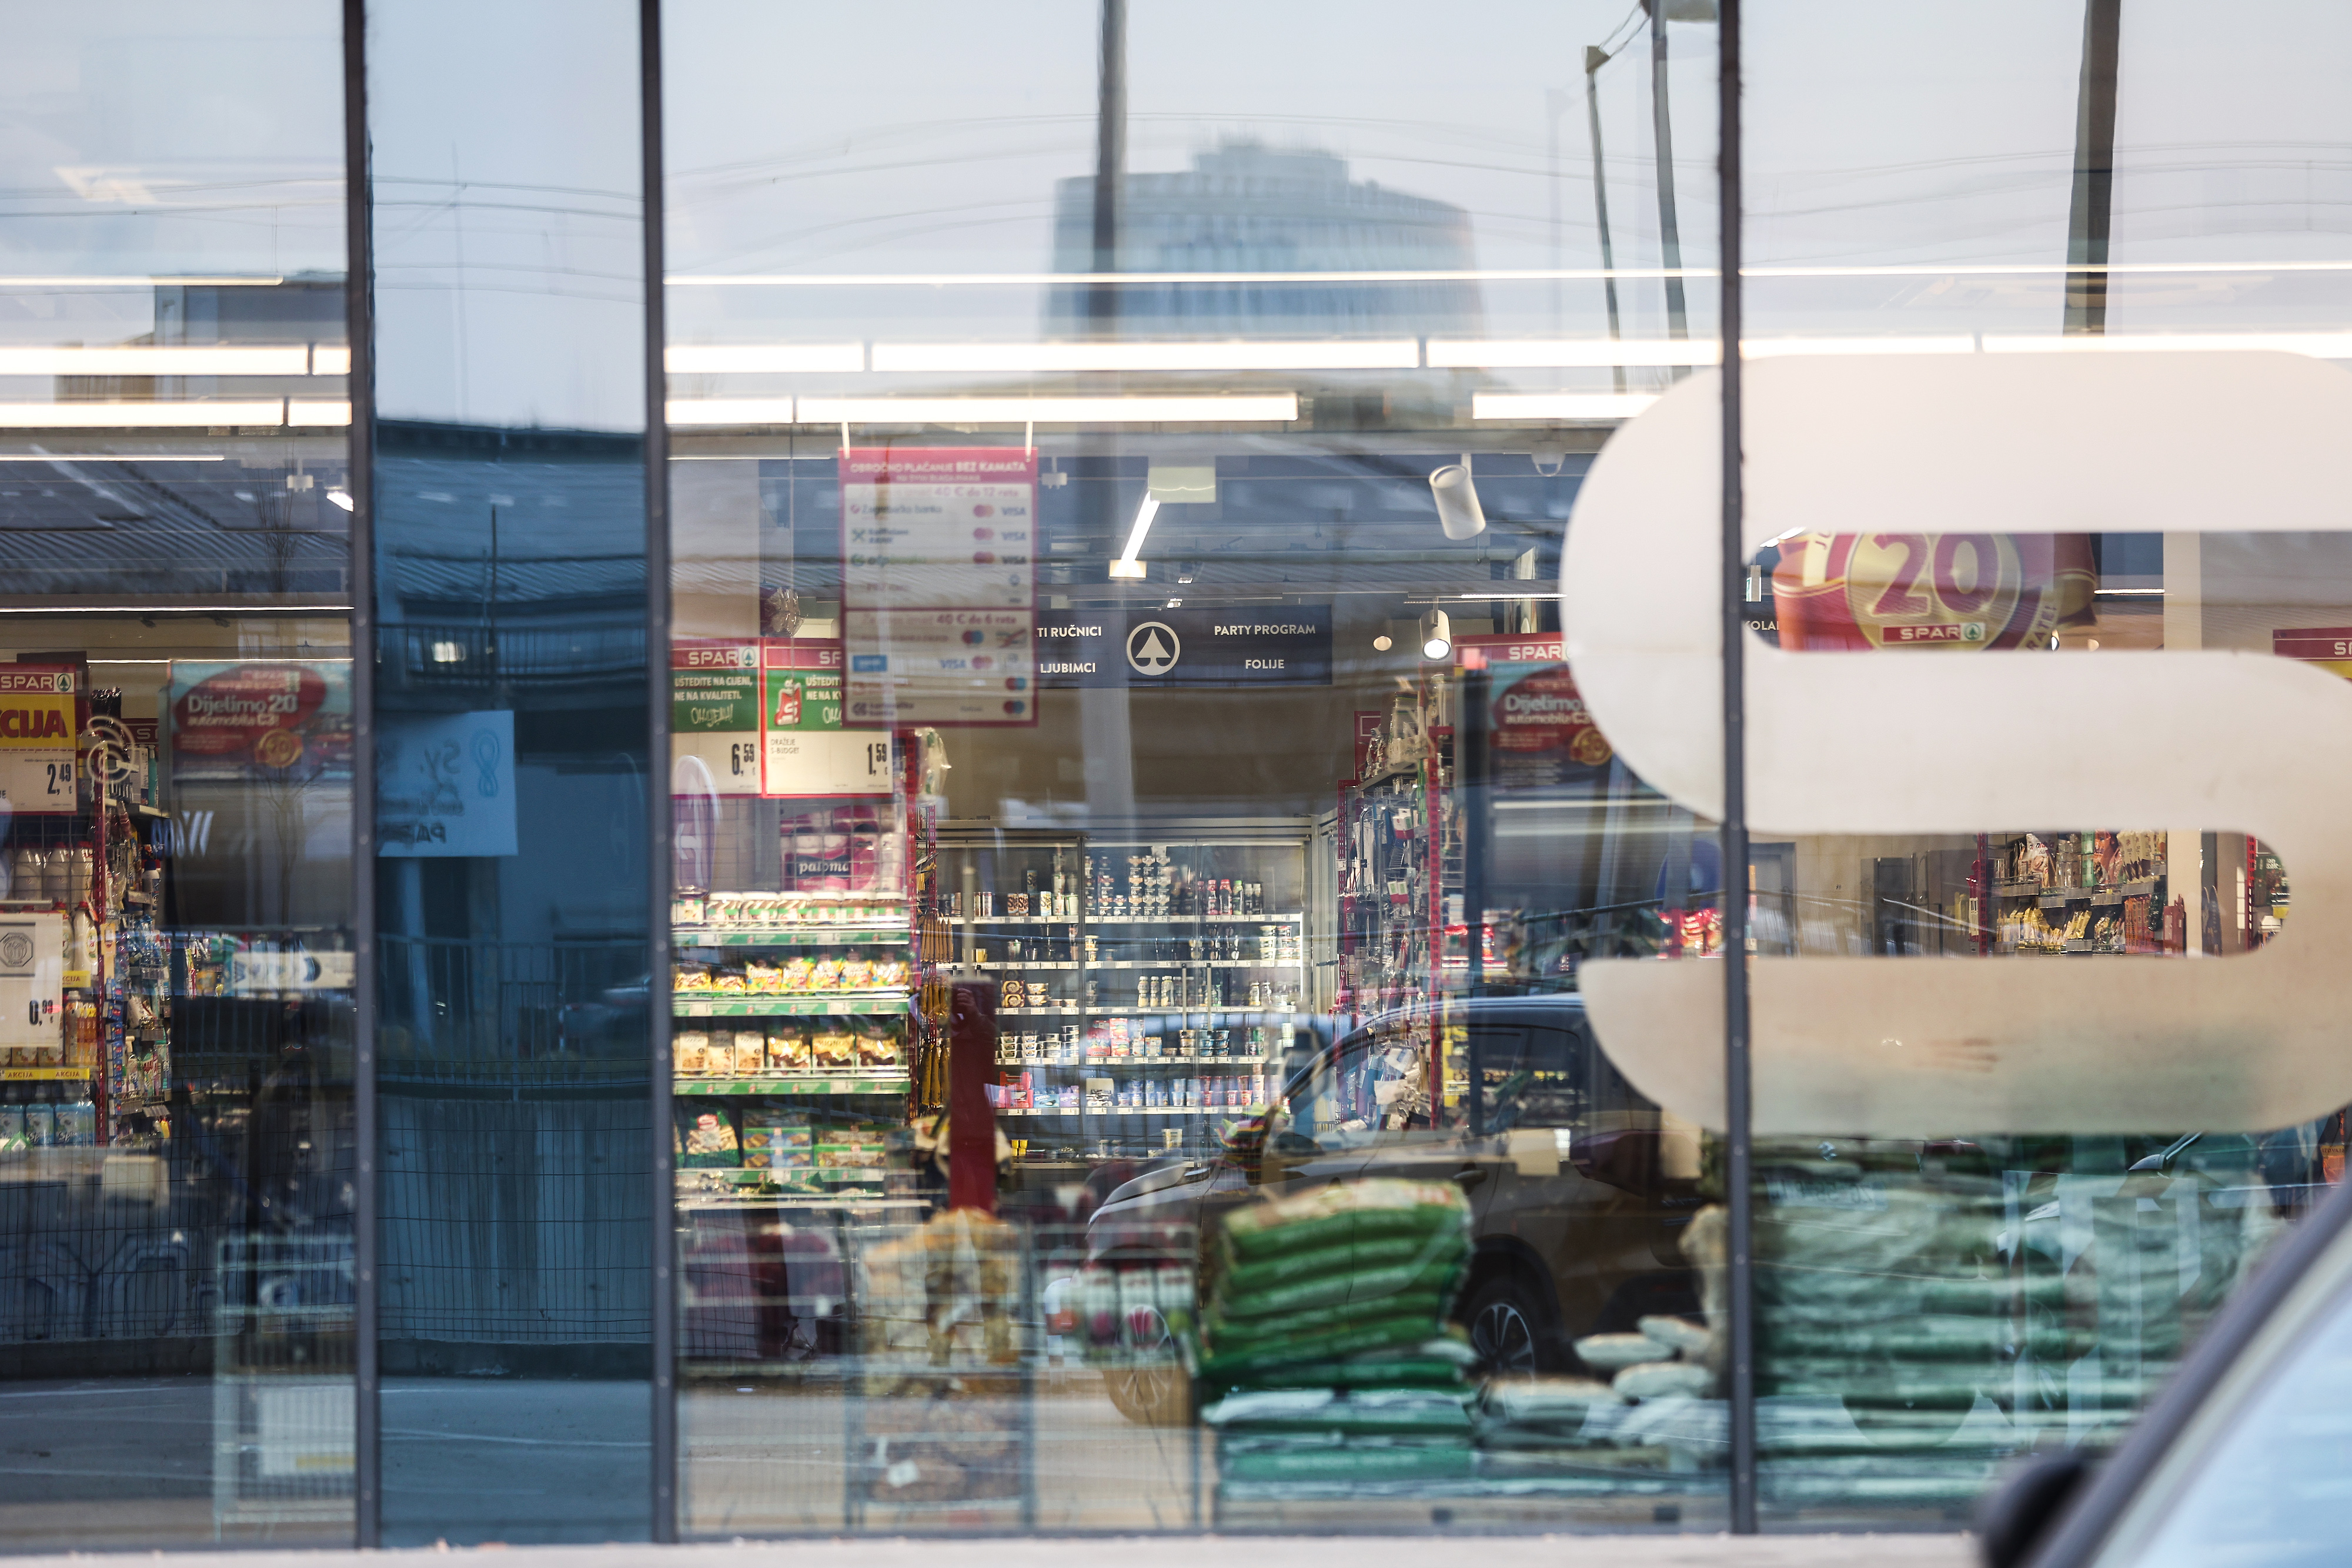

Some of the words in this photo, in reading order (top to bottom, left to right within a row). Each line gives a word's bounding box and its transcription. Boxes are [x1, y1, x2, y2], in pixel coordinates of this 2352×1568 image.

[1051, 624, 1101, 637] RUČNICI
[1215, 625, 1251, 636] PARTY
[1254, 624, 1316, 635] PROGRAM
[1900, 626, 1960, 640] SPAR
[689, 651, 739, 665] SPAR
[1508, 646, 1562, 660] SPAR
[1040, 663, 1095, 673] LJUBIMCI
[1245, 659, 1285, 670] FOLIJE
[1, 676, 53, 689] SPAR
[674, 675, 711, 687] UŠTEDITE
[713, 677, 725, 686] NA
[674, 692, 684, 701] NE
[686, 691, 699, 700] NA
[188, 694, 268, 716] Dijelimo
[268, 694, 298, 713] 20
[0, 710, 68, 738] CIJA
